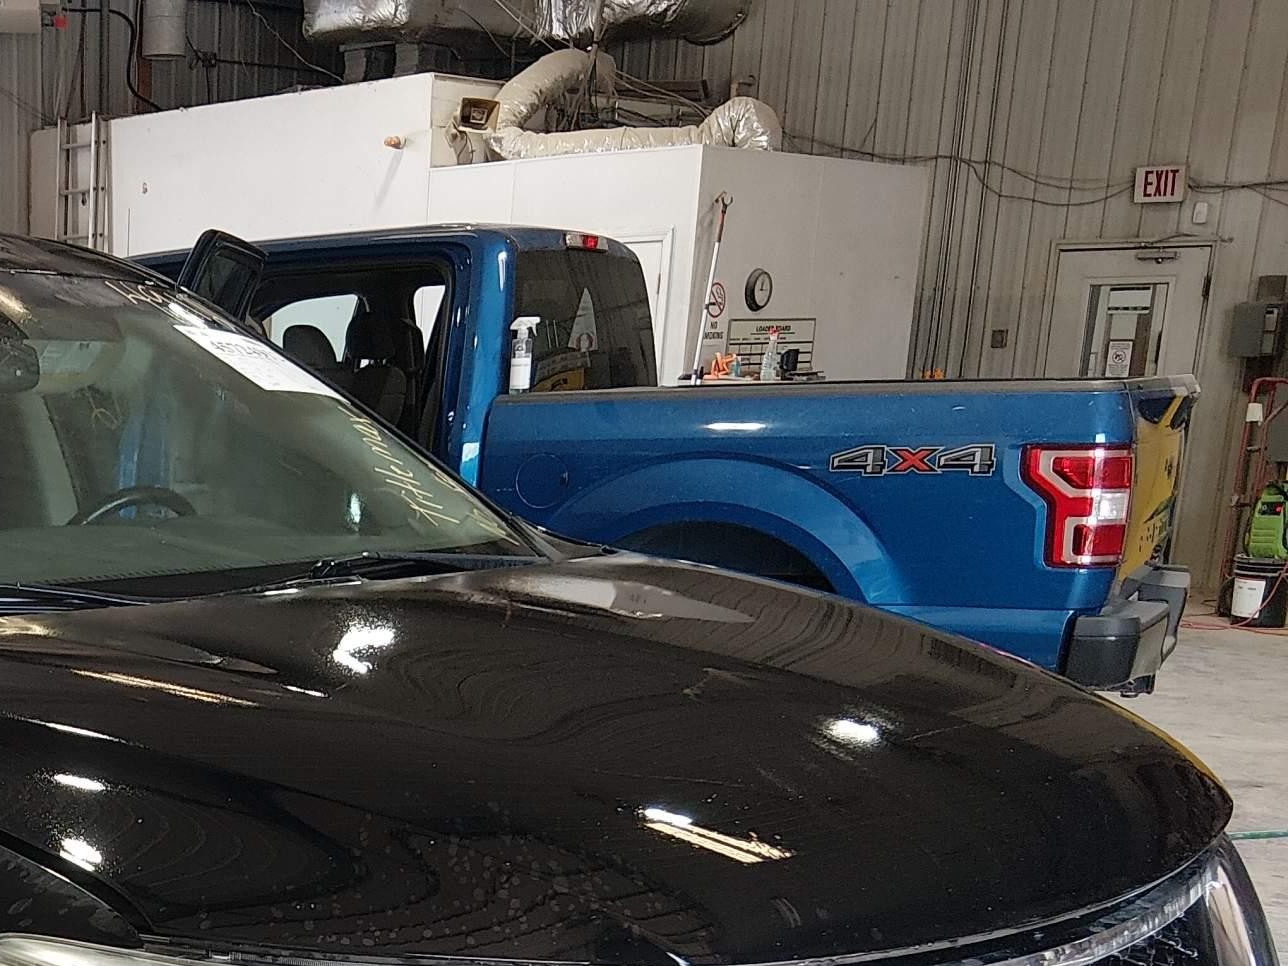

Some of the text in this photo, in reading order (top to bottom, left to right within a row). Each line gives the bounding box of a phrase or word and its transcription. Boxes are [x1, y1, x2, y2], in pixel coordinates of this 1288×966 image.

[1143, 169, 1179, 197] EXIT
[710, 321, 718, 330] NO
[704, 331, 723, 340] MOKING
